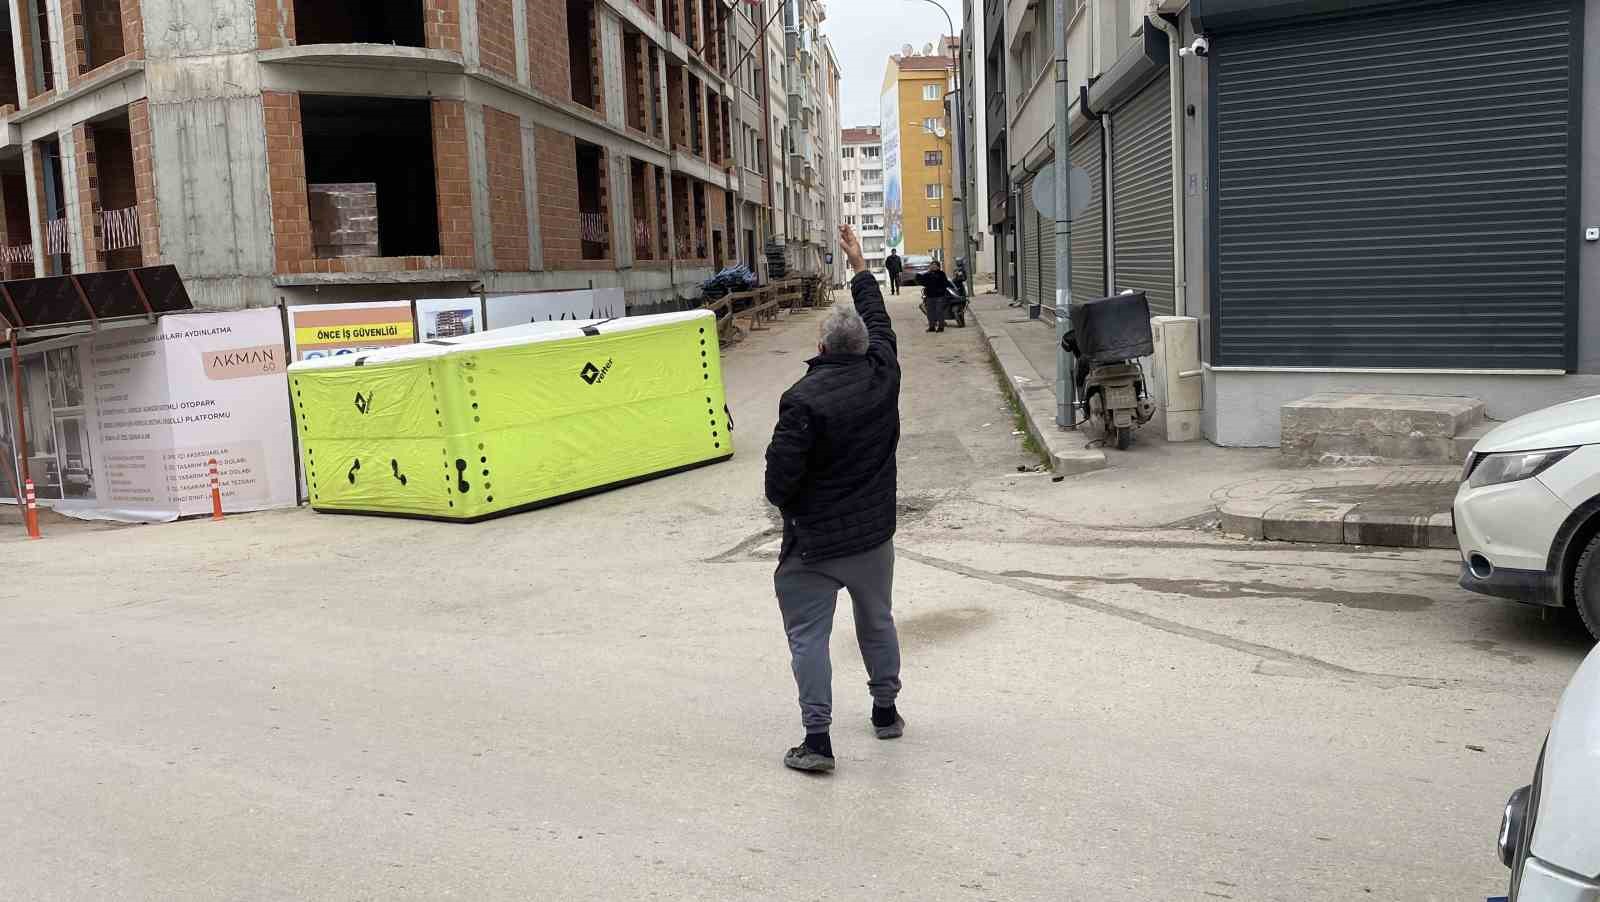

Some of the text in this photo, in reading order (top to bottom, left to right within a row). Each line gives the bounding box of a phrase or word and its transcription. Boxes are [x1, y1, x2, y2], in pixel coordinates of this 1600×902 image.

[317, 325, 398, 340] ÖNCE İŞ GÜVENLİĞİ
[212, 348, 274, 369] AKMAN
[596, 357, 614, 384] vetter
[180, 399, 216, 410] OTOPARK
[185, 411, 231, 424] PLATFORMU
